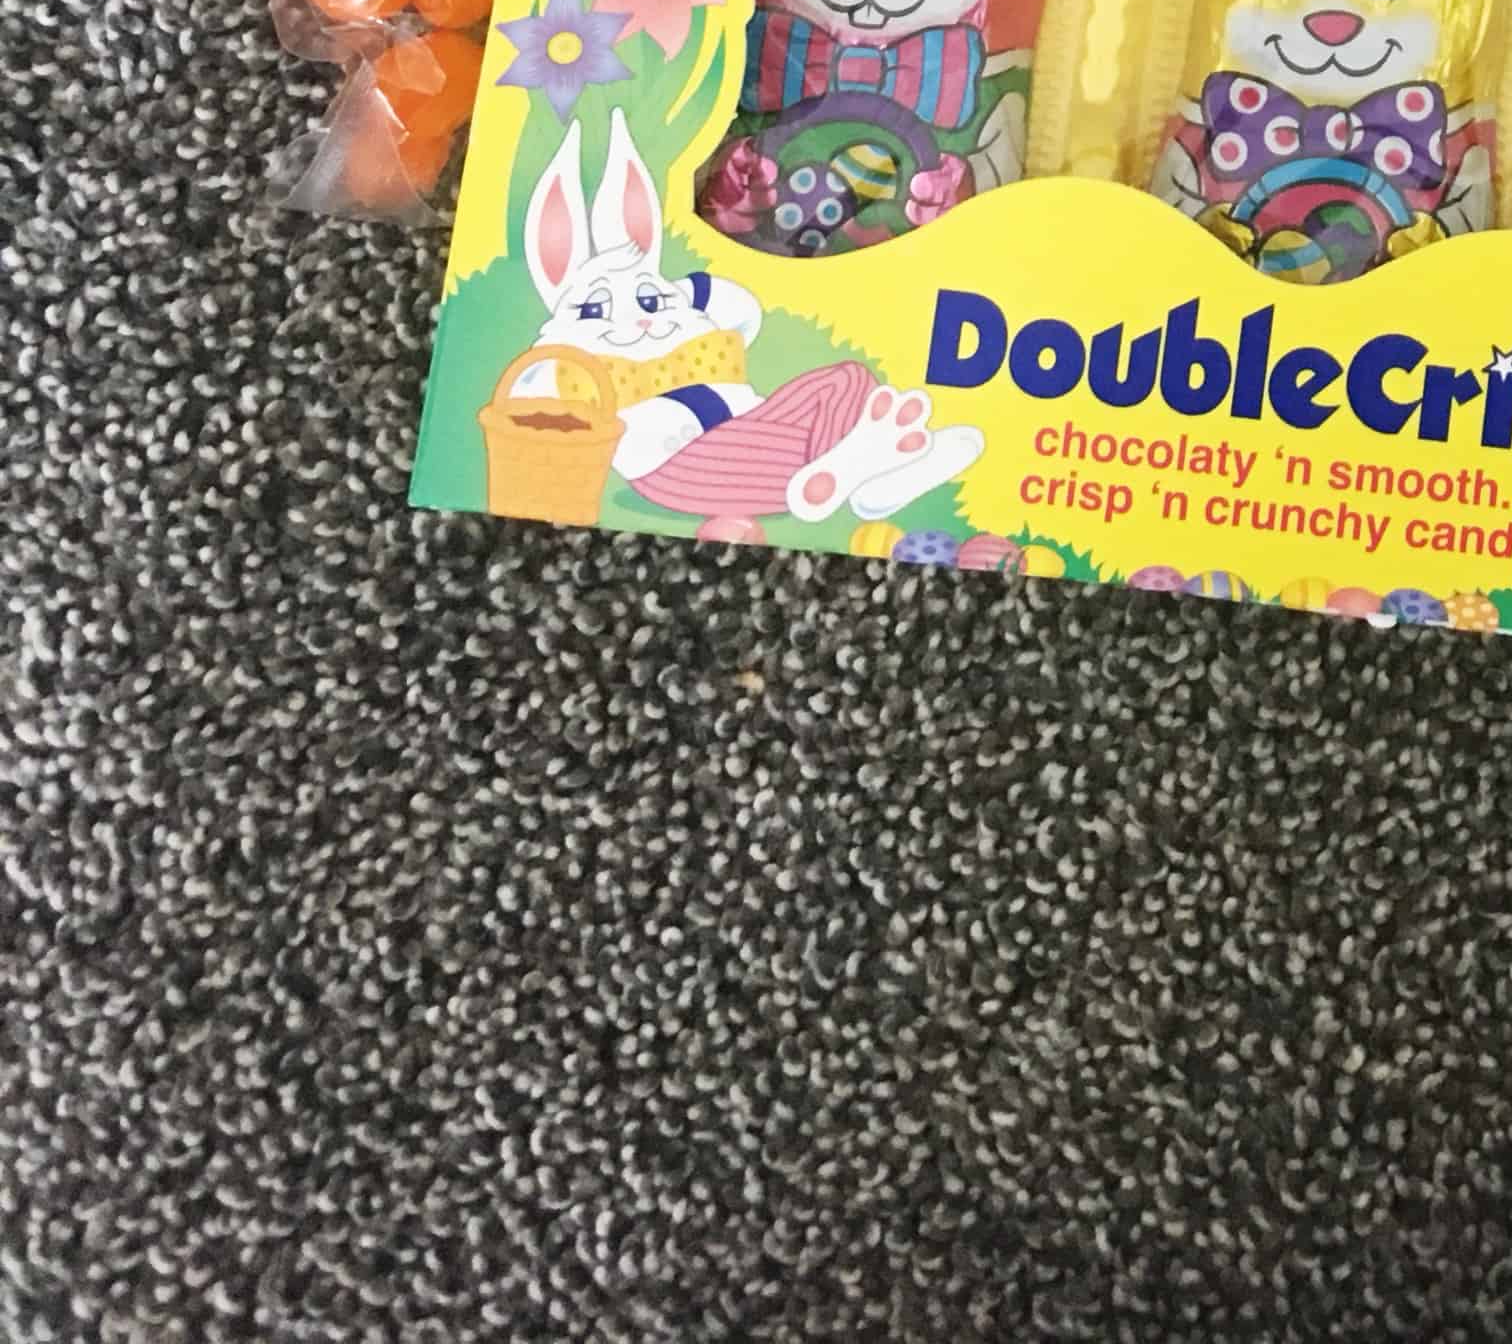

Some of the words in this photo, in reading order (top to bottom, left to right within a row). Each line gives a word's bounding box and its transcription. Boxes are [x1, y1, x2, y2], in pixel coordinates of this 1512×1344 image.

[1034, 421, 1257, 488] chocolaty
[1019, 471, 1133, 523] crisp
[1205, 494, 1391, 553] crunchy
